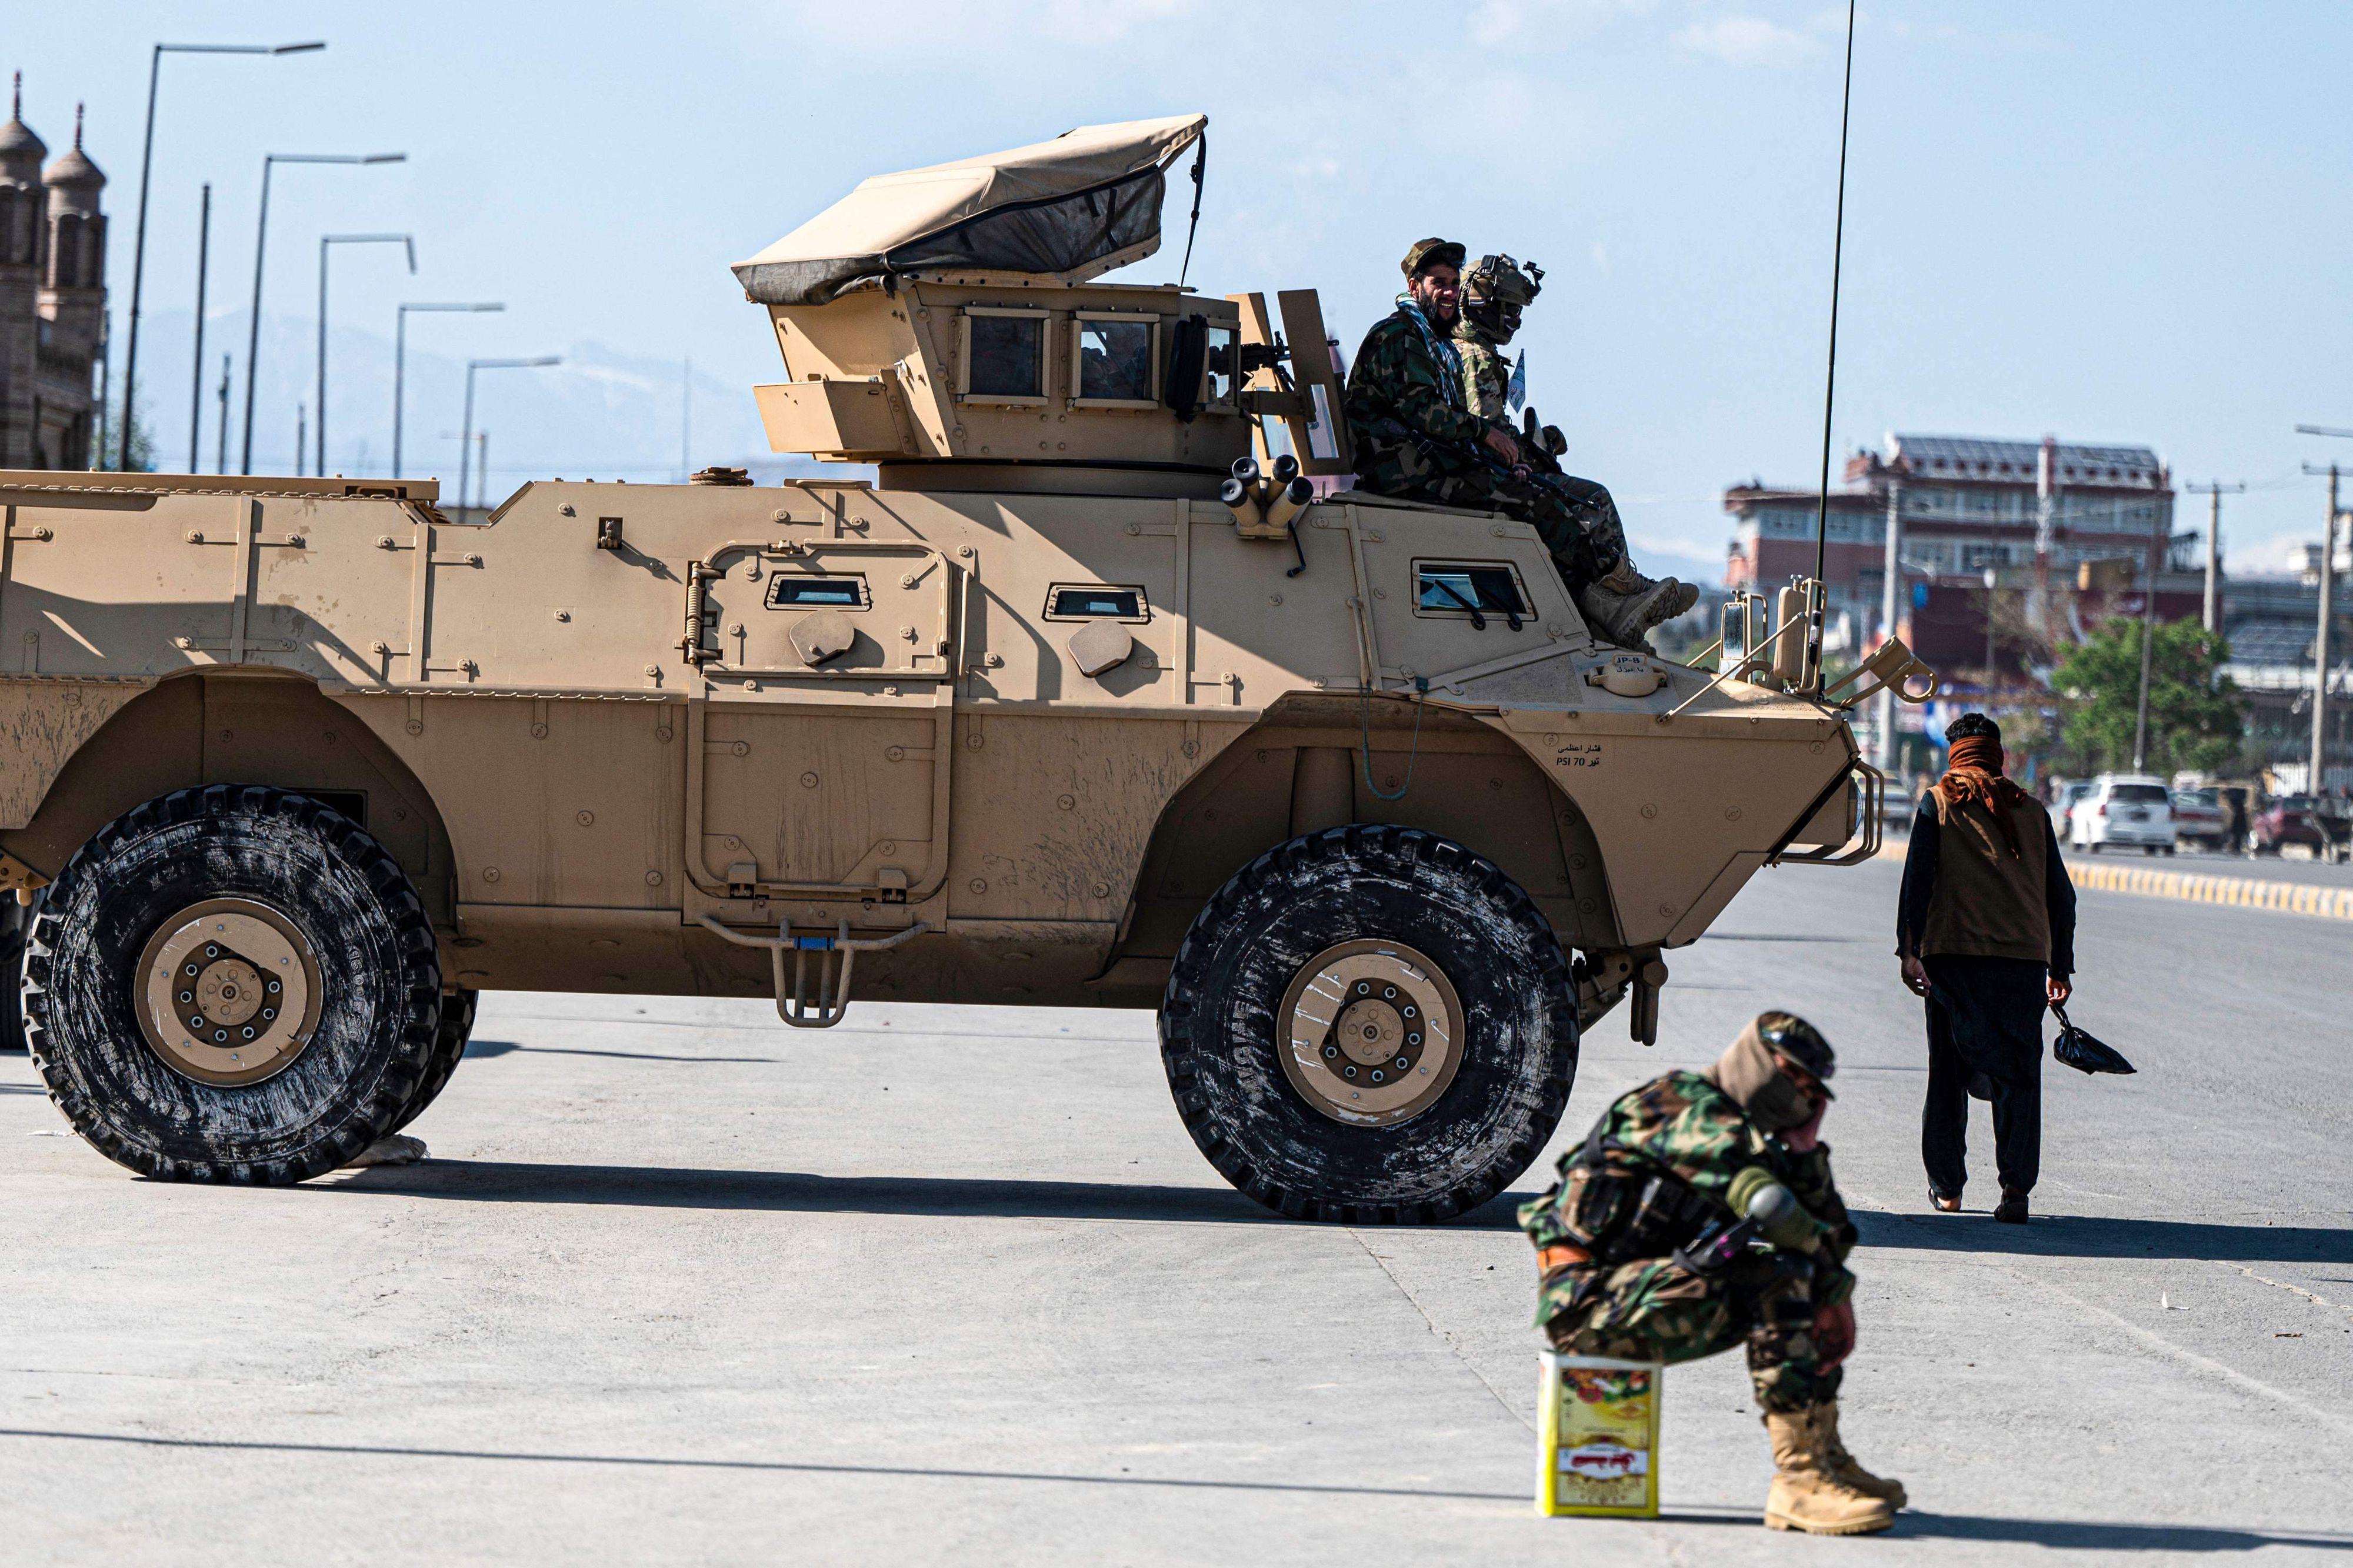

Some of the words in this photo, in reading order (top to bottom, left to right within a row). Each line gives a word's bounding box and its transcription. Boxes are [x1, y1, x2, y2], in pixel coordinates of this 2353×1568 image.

[1584, 744, 1601, 753] فشار
[1557, 758, 1571, 766] PSI
[1574, 758, 1585, 766] 70
